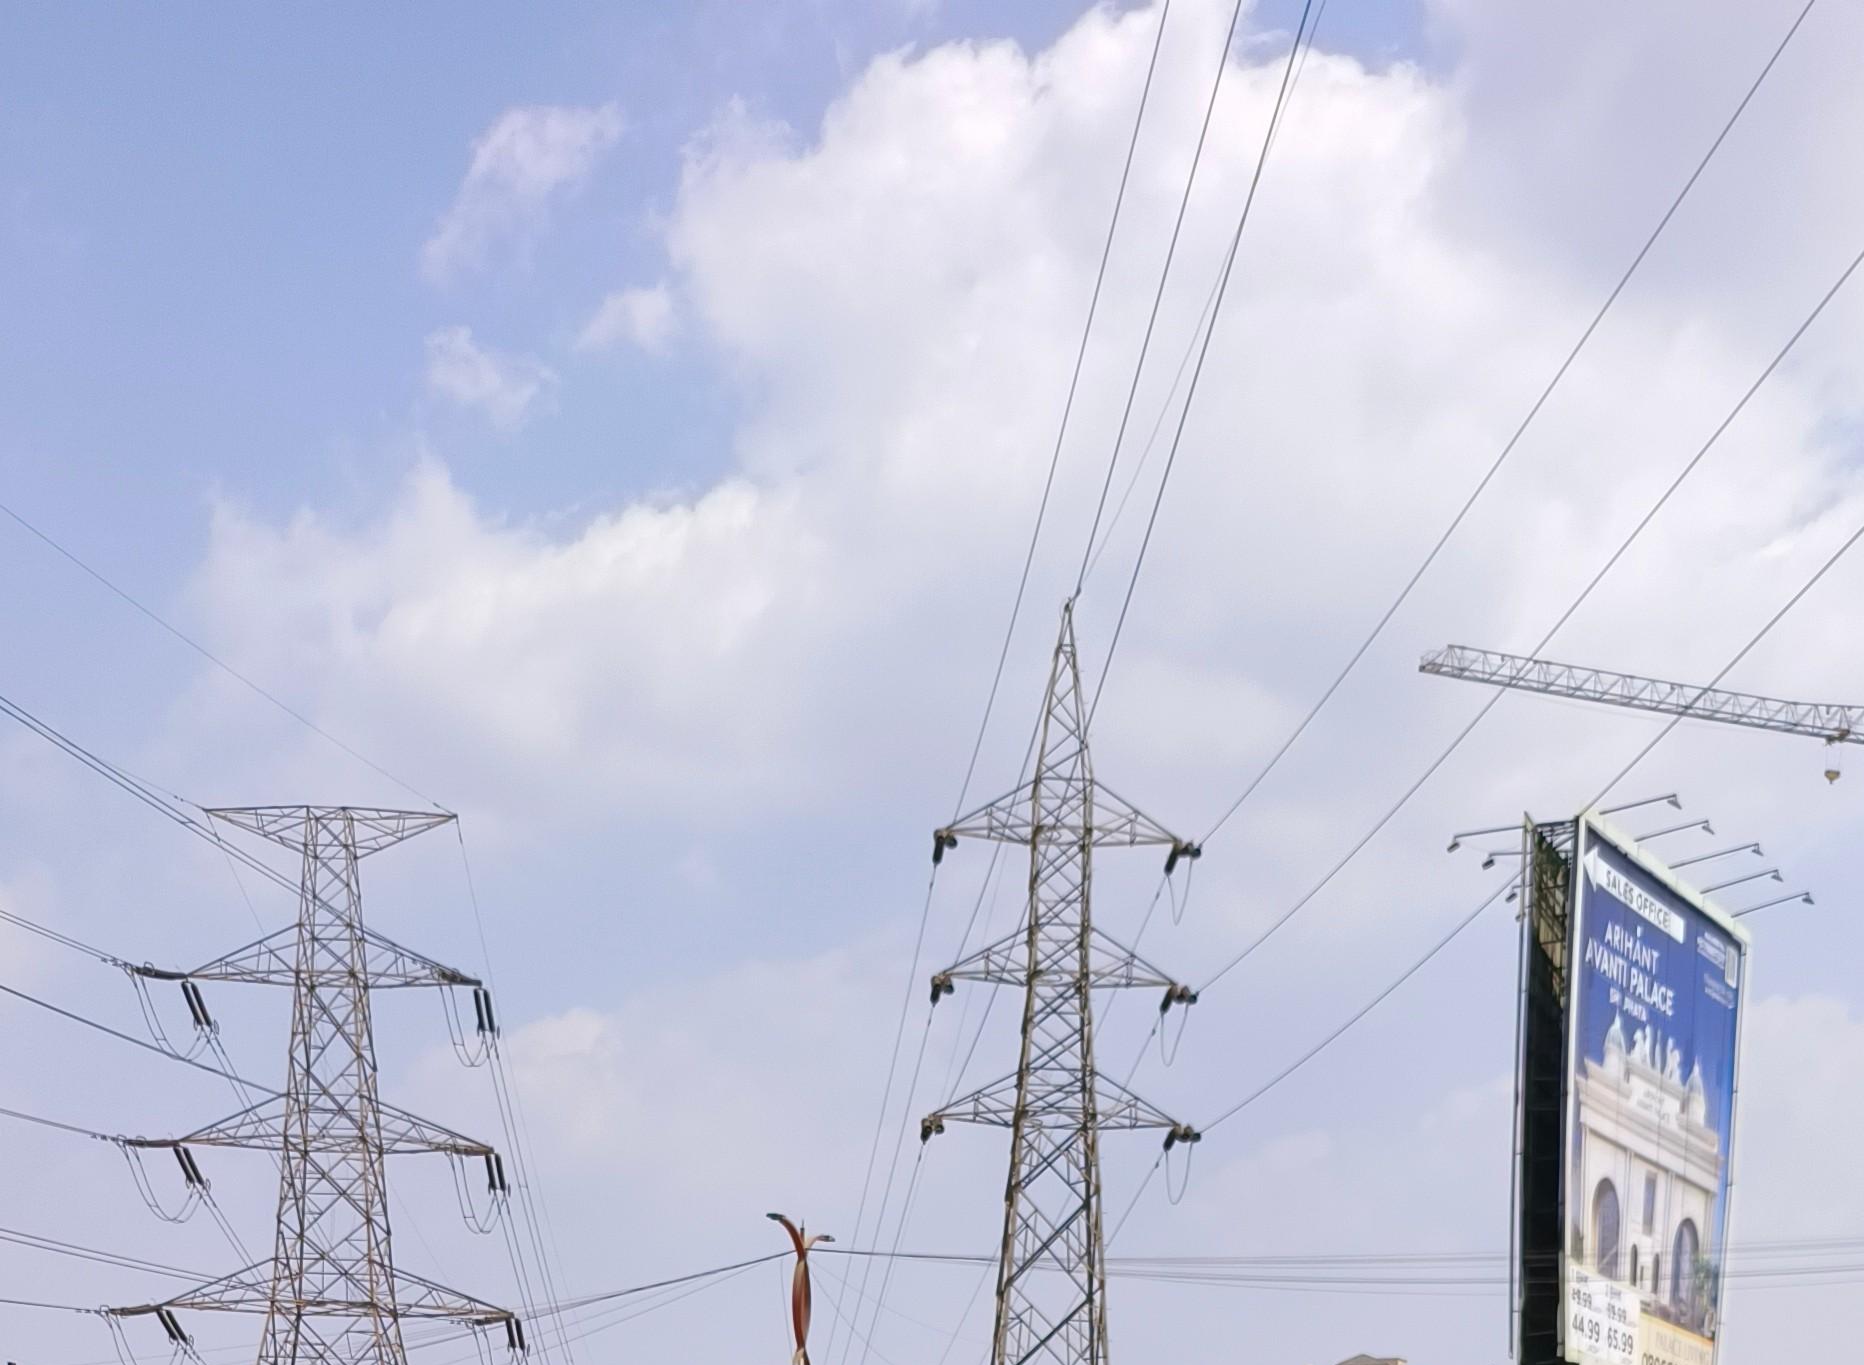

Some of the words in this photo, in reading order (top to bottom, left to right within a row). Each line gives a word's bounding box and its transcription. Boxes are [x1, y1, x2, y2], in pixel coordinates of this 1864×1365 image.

[1605, 870, 1634, 905] SALES
[1636, 894, 1670, 929] OFFICE
[1604, 920, 1660, 975] ARIHANT
[1585, 937, 1628, 990] AVANTI
[1629, 966, 1675, 1017] PALACE
[1572, 1313, 1601, 1344] 44.99
[1607, 1327, 1634, 1356] 65.99
